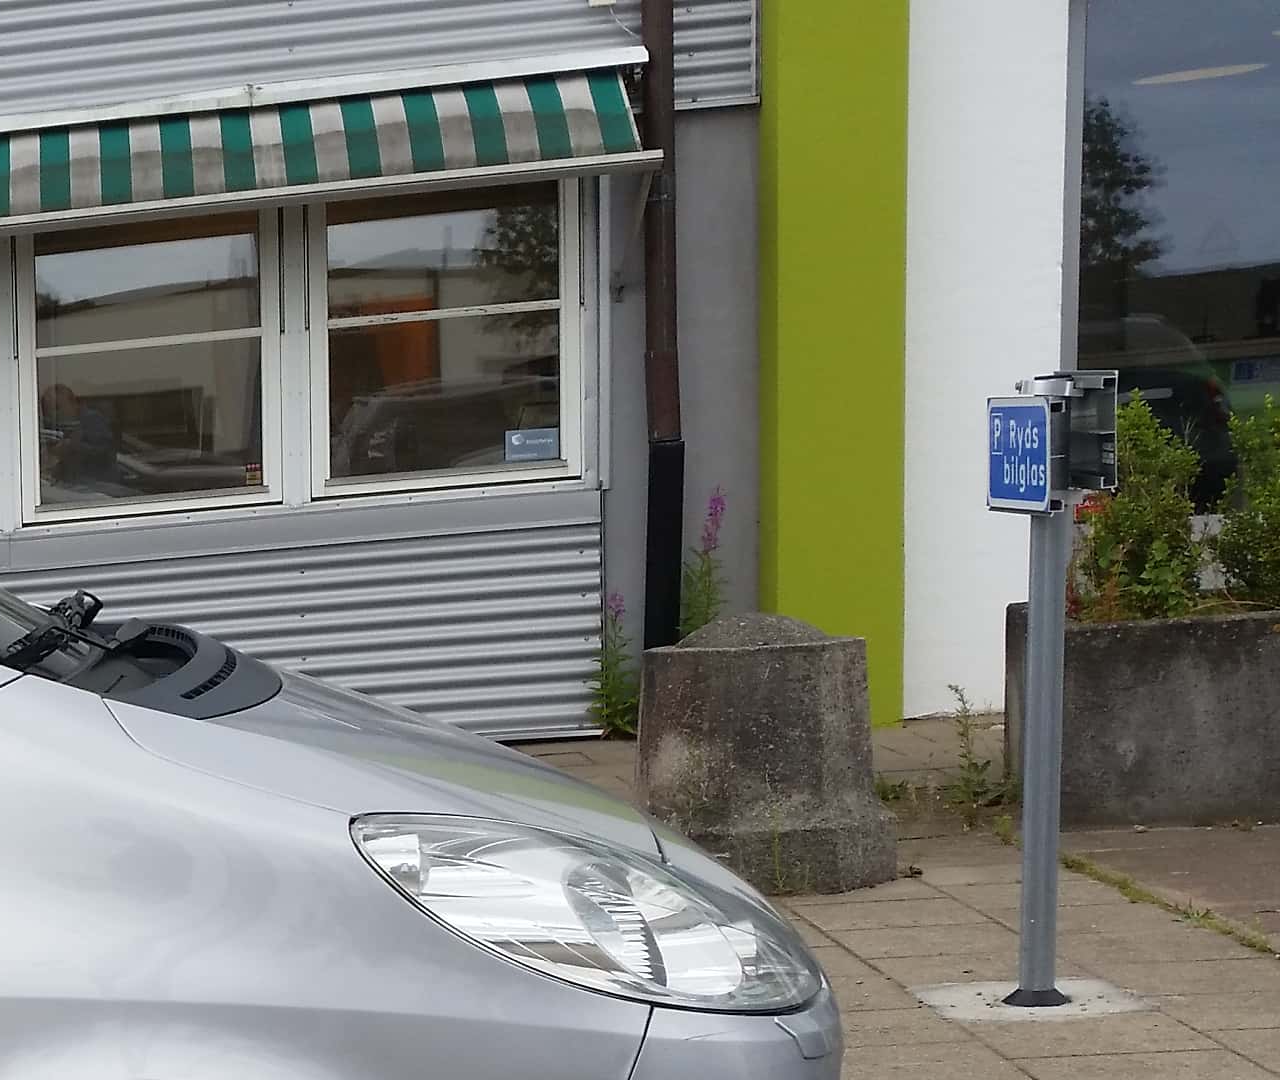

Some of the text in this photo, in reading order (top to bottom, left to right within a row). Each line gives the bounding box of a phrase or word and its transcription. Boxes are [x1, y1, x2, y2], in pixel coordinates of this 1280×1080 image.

[993, 418, 1039, 455] P Ryds
[1003, 456, 1045, 492] bilglas
